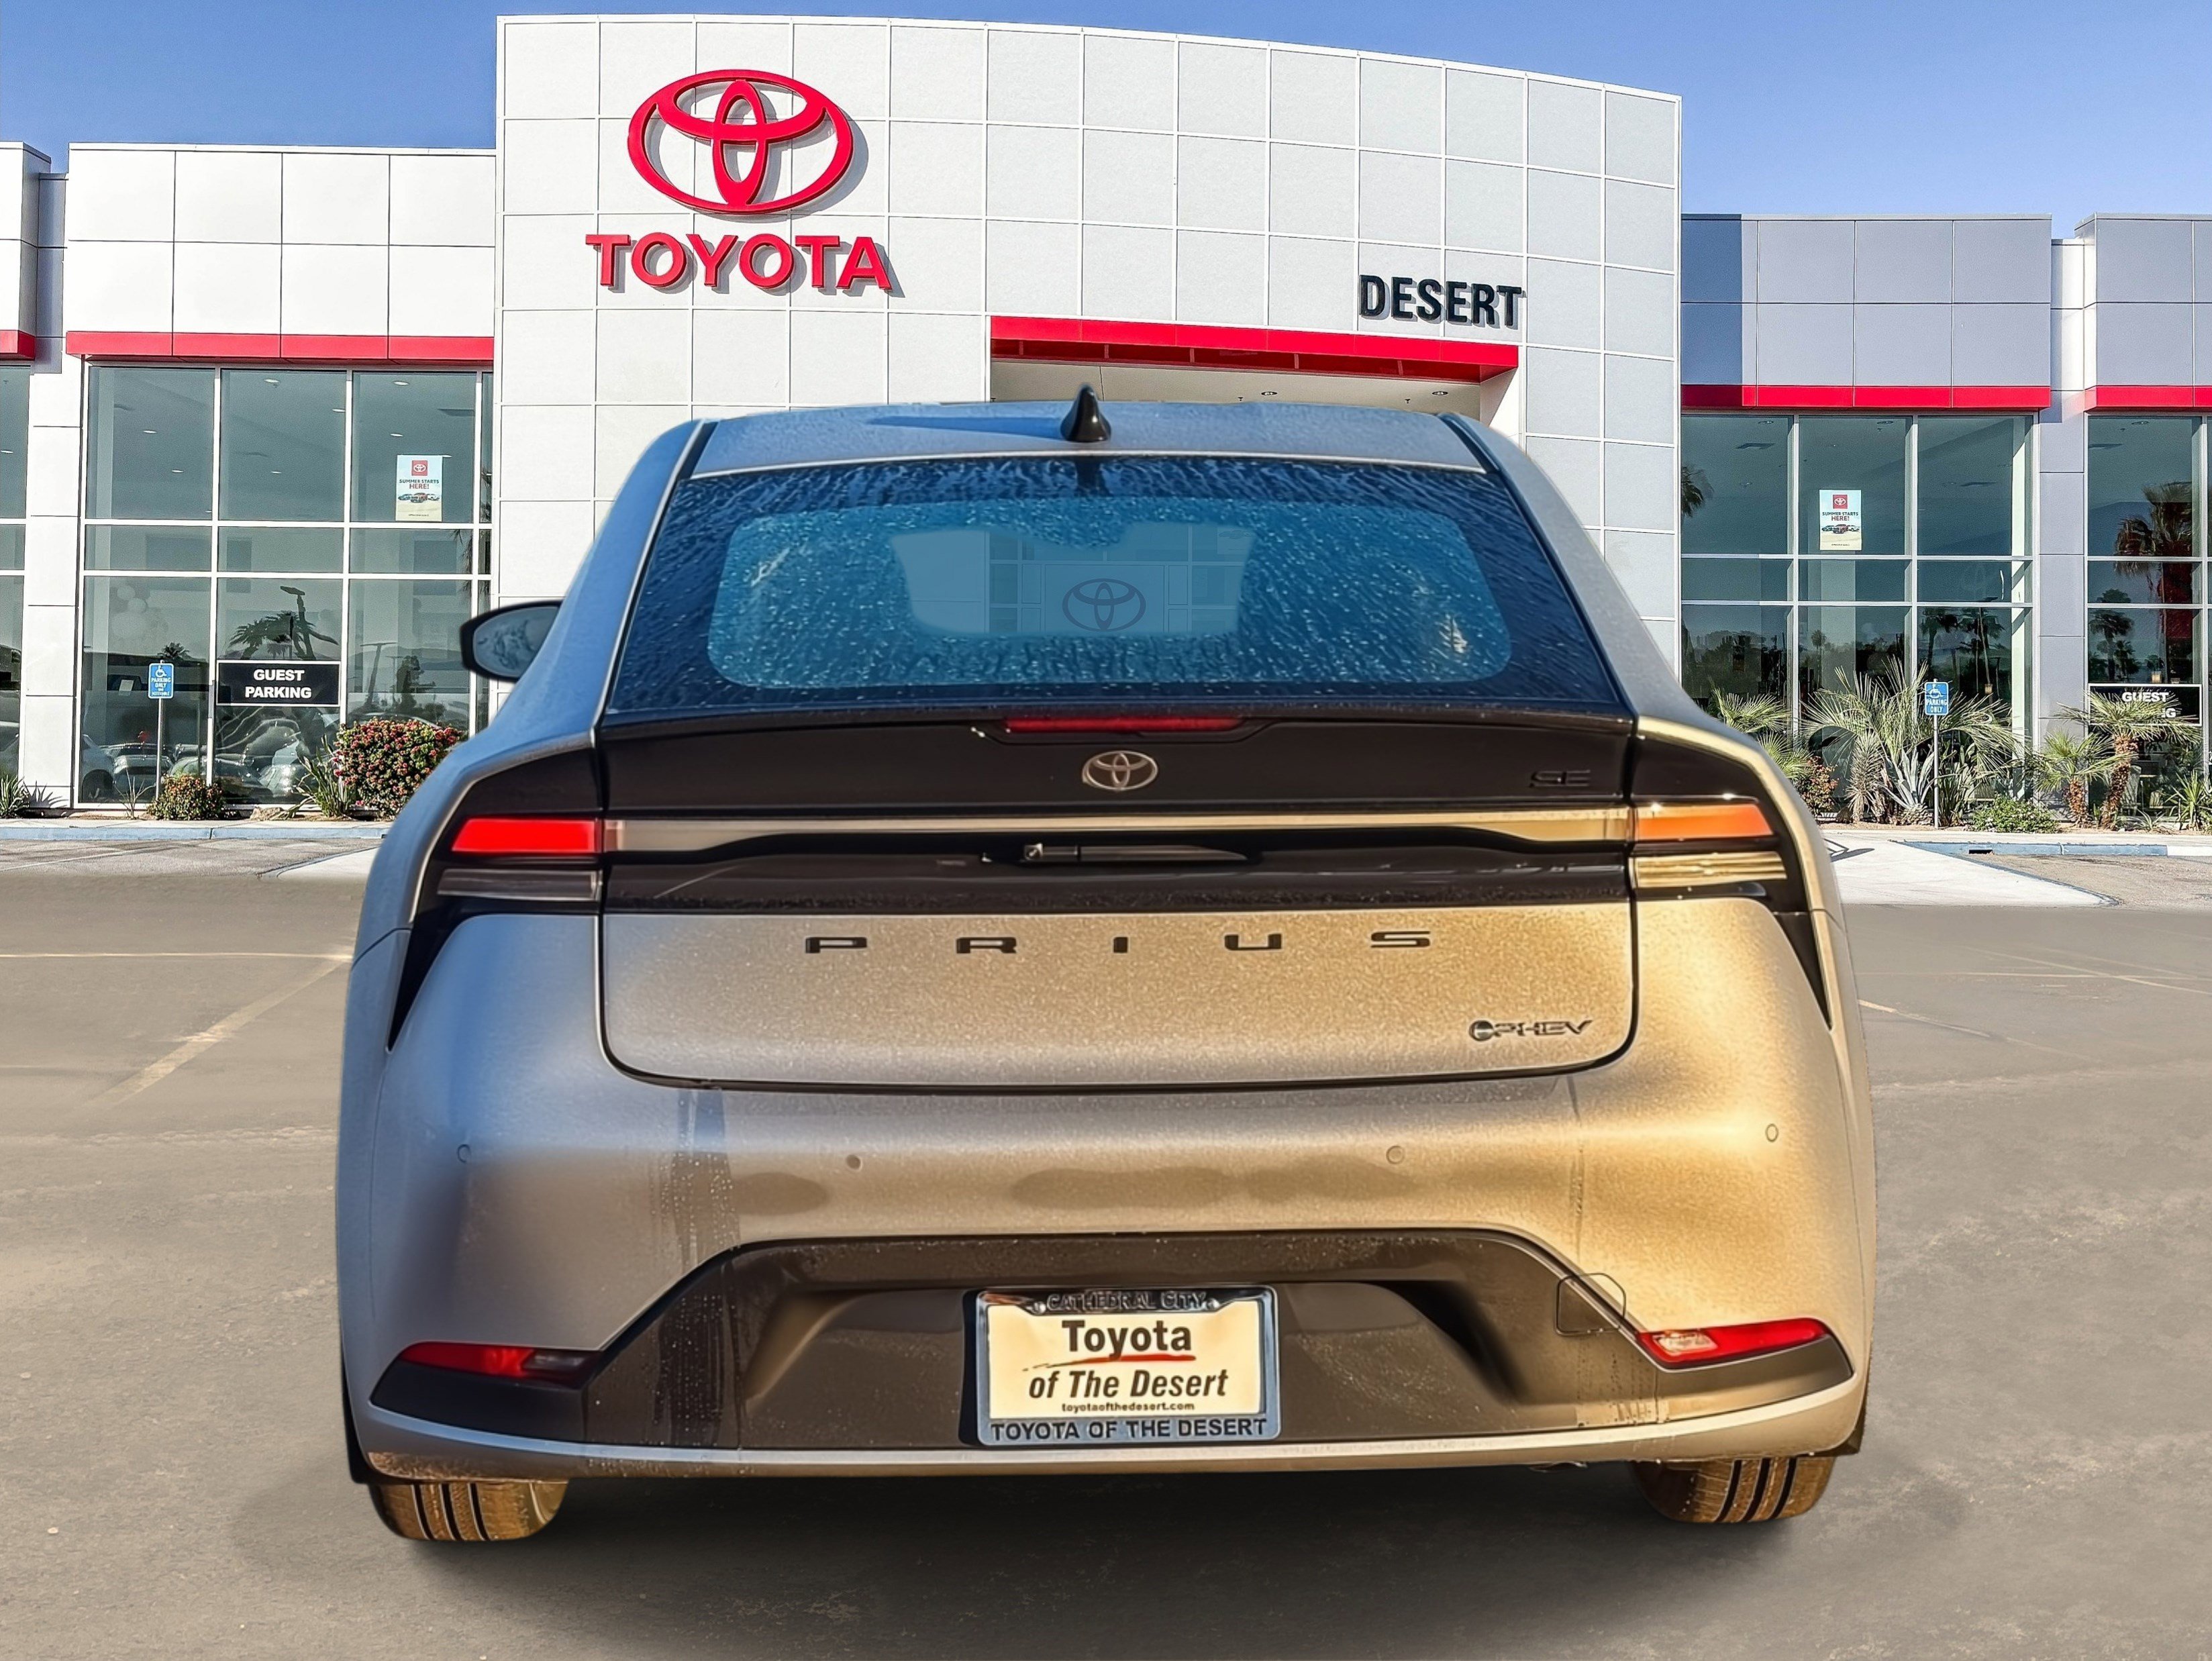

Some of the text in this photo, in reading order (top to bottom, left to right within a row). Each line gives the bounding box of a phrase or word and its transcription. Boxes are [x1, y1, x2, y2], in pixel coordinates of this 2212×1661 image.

[585, 232, 893, 291] TOYOTA
[1359, 274, 1523, 327] DESERT
[253, 669, 305, 681] GUEST
[245, 686, 312, 699] PARKING
[2121, 691, 2170, 703] GUEST
[1930, 705, 1944, 713] ONLY
[805, 930, 1431, 954] PRIUS
[1495, 1019, 1593, 1037] PHEV
[1160, 1290, 1207, 1309] CITY
[1062, 1319, 1192, 1361] Toyota
[1028, 1368, 1229, 1399] of The Desert
[1061, 1401, 1195, 1414] toyotaofthedesert.com
[991, 1417, 1267, 1442] TOYOTA OF THE DESERT
